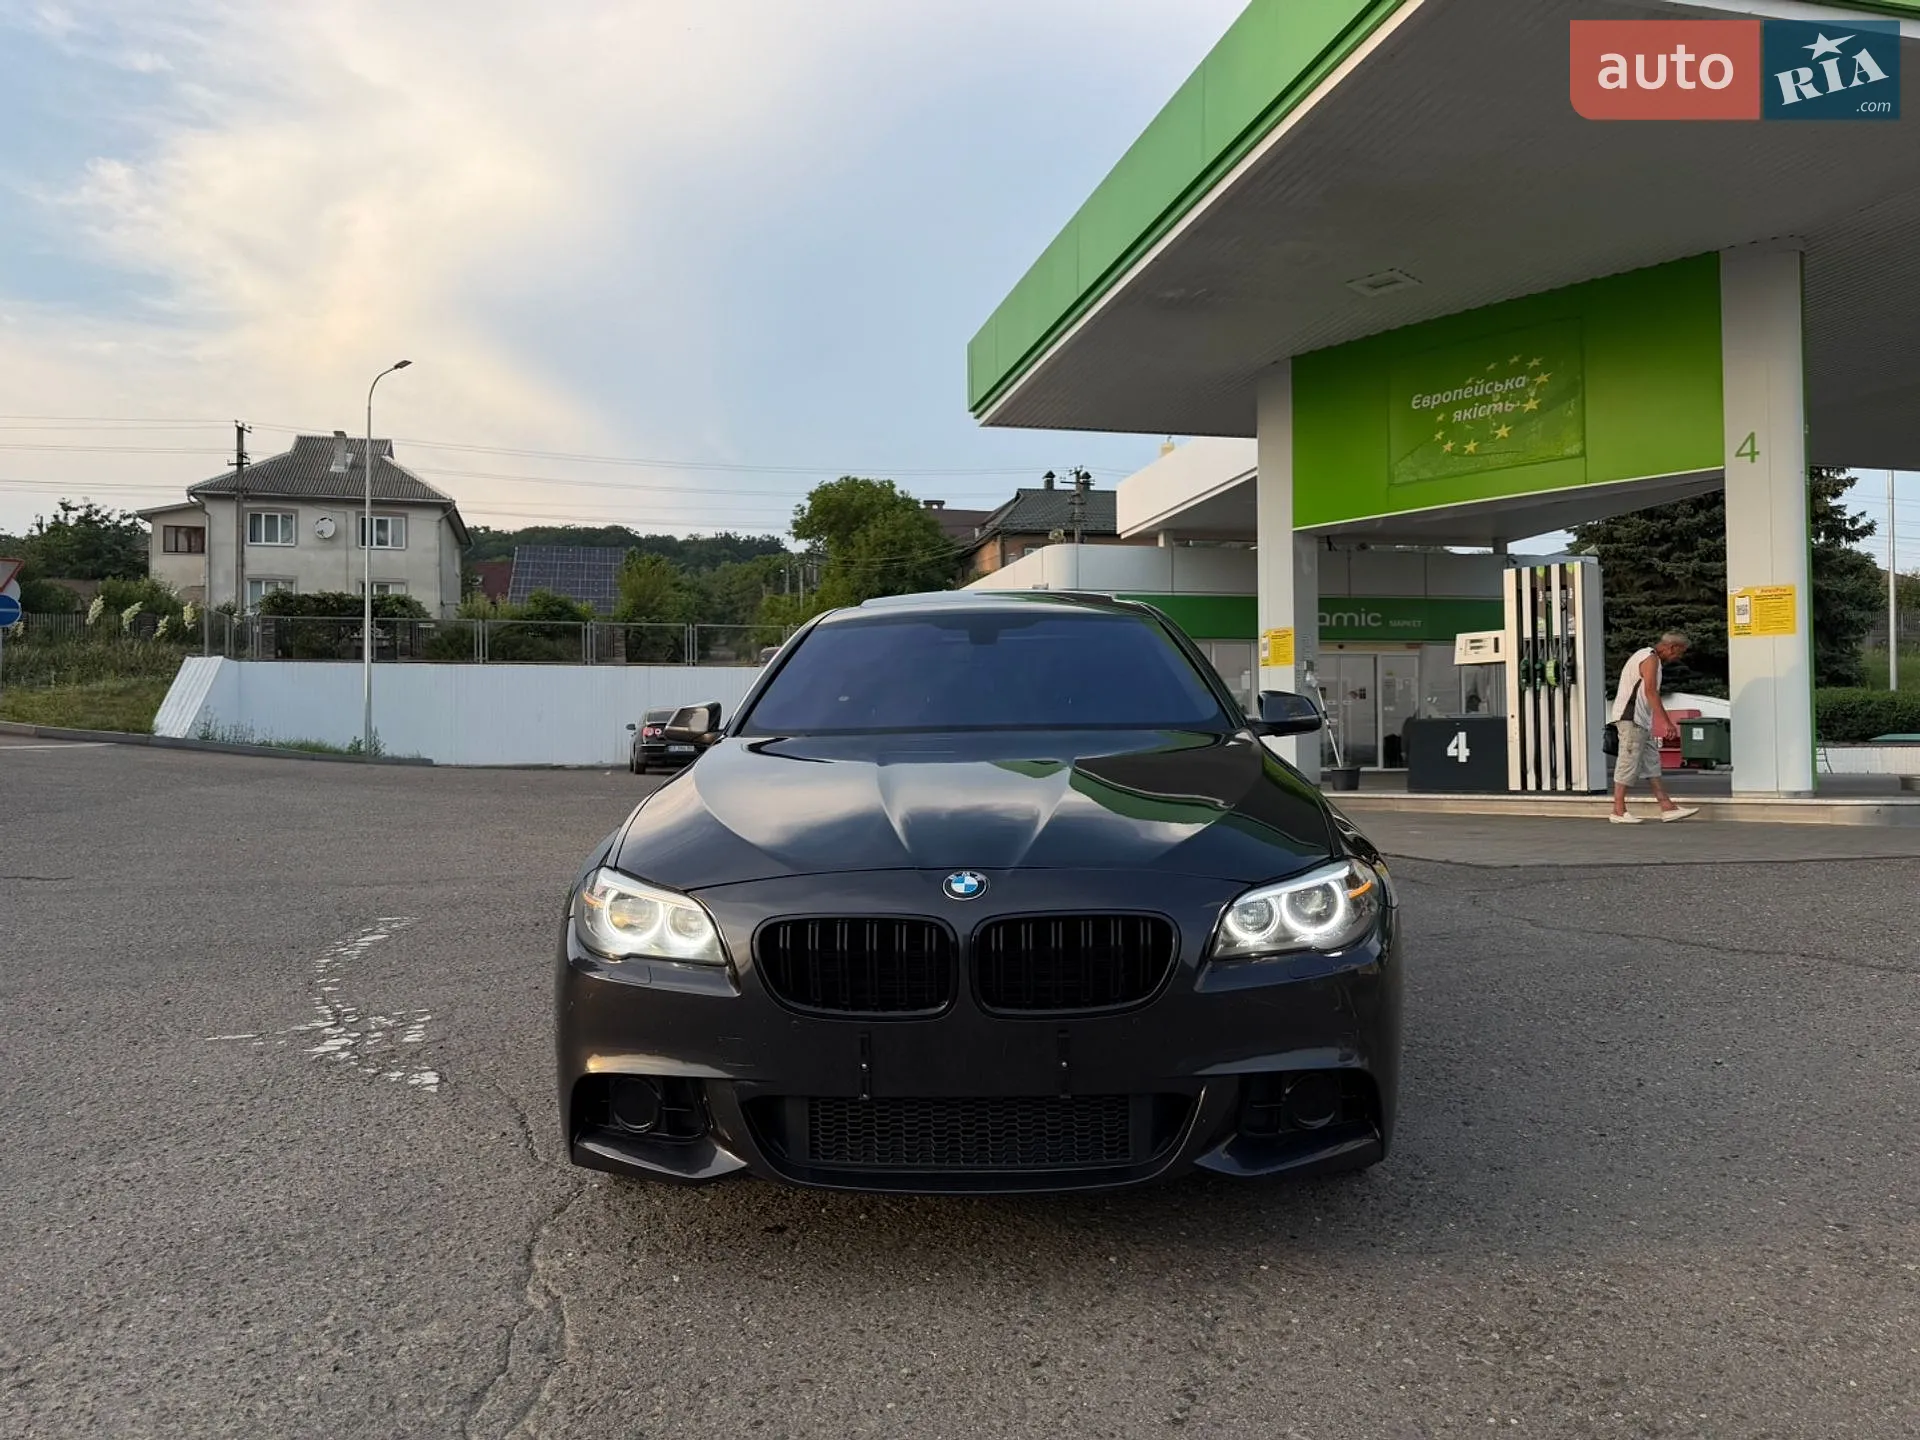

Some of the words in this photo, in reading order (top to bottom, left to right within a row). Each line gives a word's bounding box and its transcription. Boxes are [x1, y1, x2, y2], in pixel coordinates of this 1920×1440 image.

[1411, 375, 1526, 409] Європейська
[1452, 400, 1515, 423] якість
[1735, 431, 1760, 463] 4
[1447, 732, 1470, 762] 4
